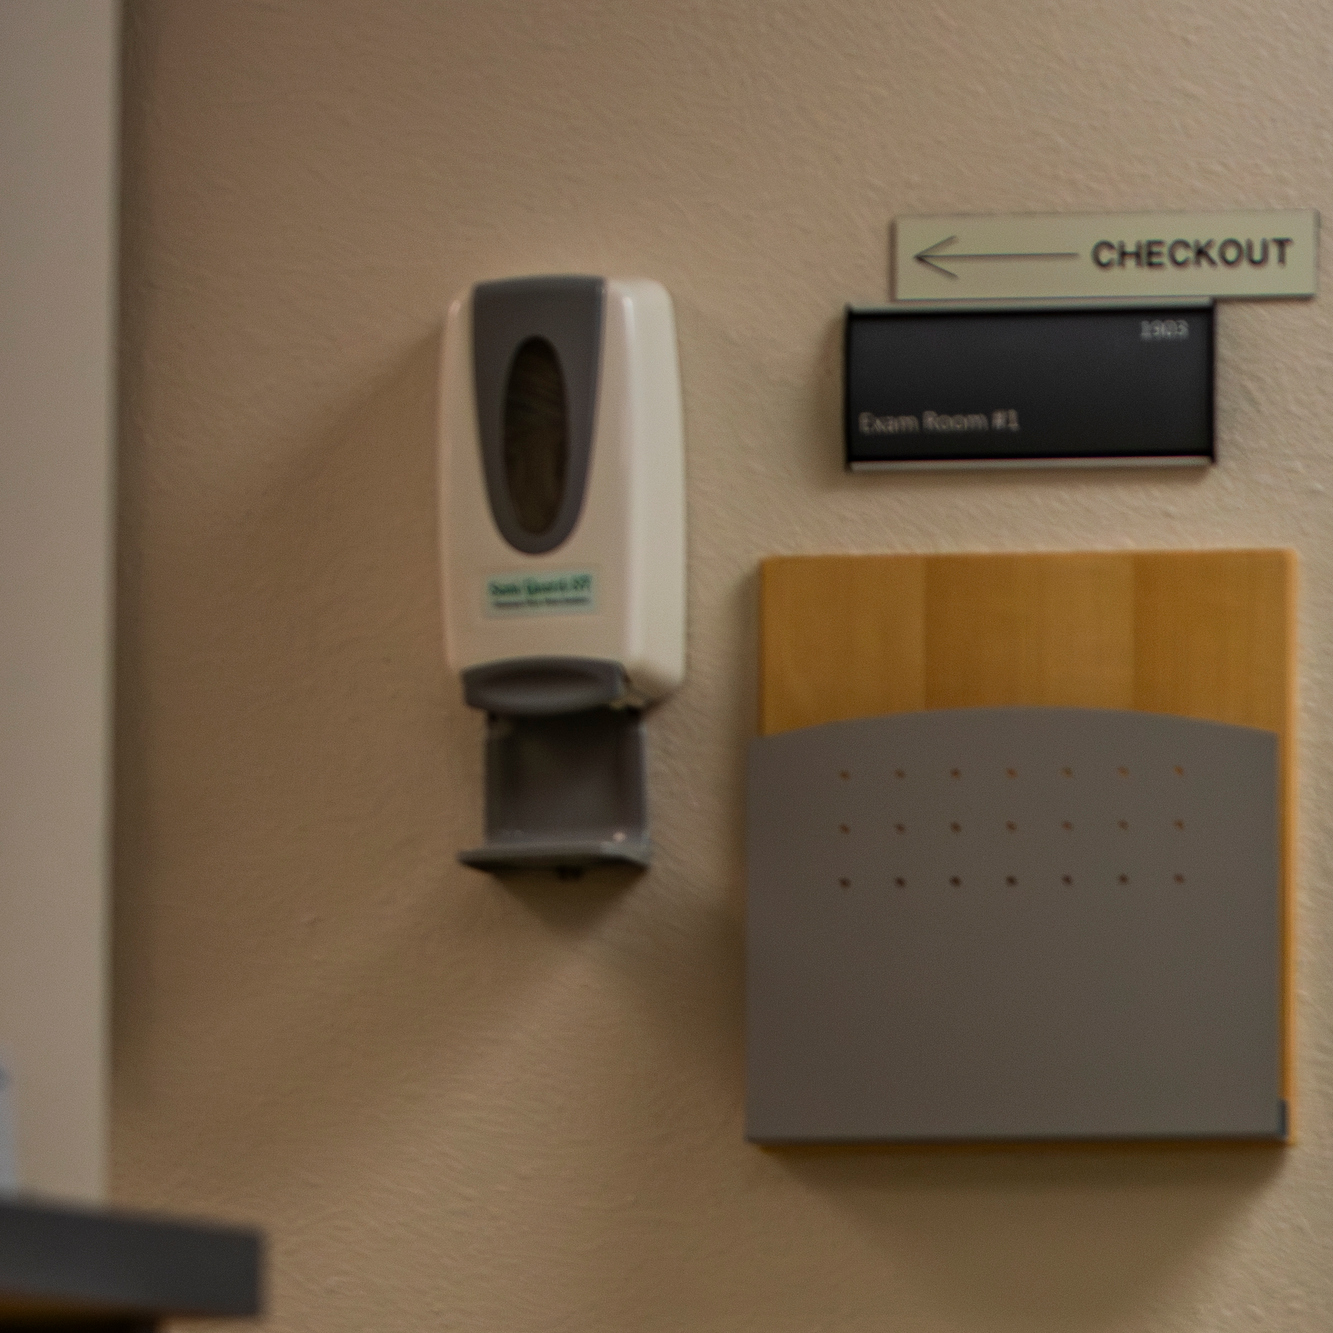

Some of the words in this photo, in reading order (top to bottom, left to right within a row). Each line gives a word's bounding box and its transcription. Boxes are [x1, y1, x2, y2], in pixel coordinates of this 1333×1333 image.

[1091, 237, 1294, 268] CHECKOUT
[858, 412, 919, 434] Exam
[923, 409, 988, 432] Room
[991, 409, 1020, 432] #1
